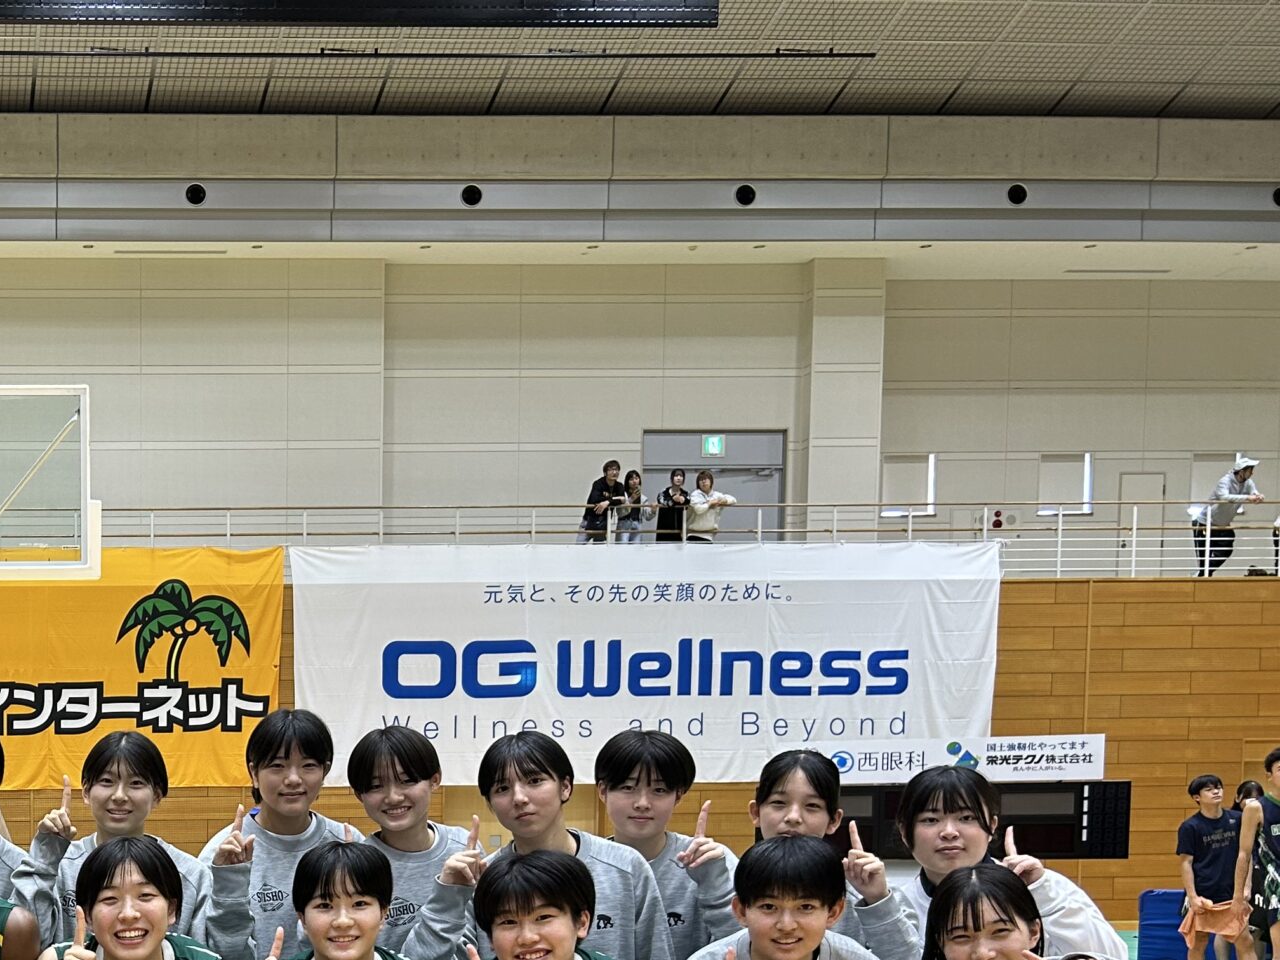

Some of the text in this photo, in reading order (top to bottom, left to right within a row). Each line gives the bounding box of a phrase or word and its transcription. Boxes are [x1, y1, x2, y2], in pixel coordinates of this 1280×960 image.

[483, 582, 793, 604] 元気と、その先の笑顔のために。
[381, 637, 910, 700] OG Wellness
[628, 712, 704, 738] and
[740, 711, 907, 742] Beyond
[985, 752, 1094, 766] 栄光テクノ株式会社
